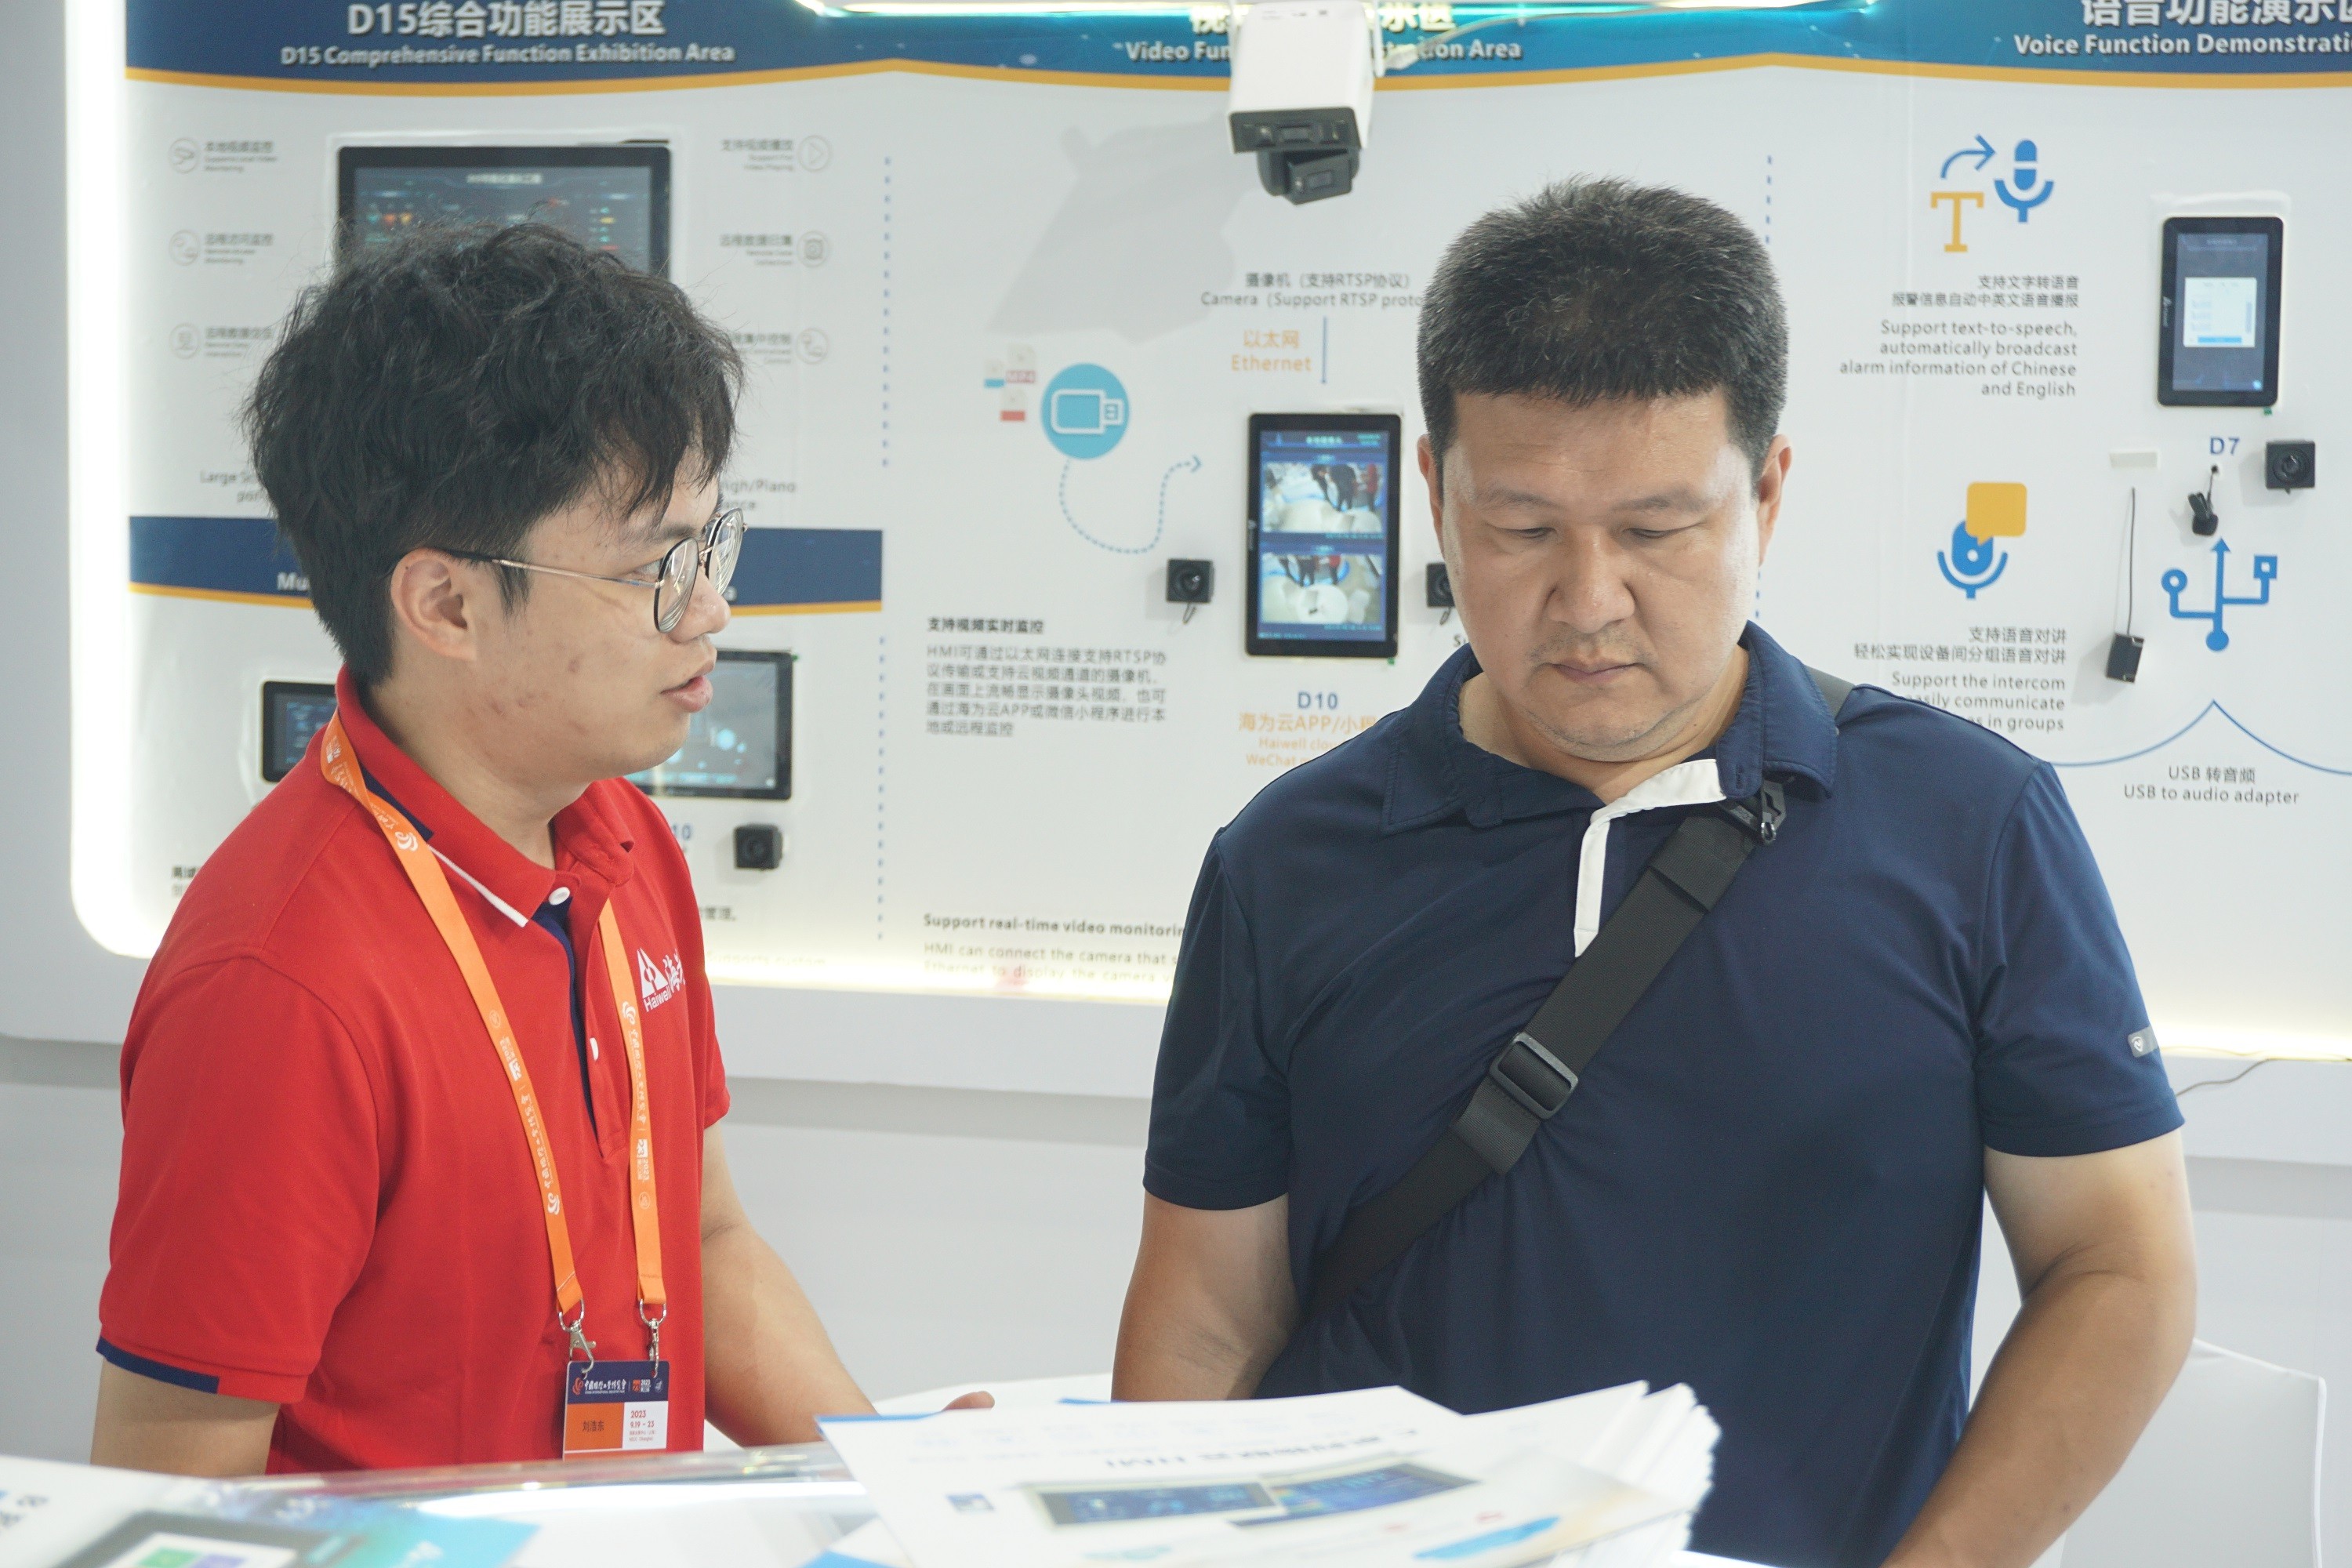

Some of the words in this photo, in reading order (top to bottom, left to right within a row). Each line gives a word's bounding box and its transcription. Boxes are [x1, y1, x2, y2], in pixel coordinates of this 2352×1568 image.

[347, 0, 666, 38] D15综合功能展示区
[1126, 41, 1191, 62] Video
[1194, 40, 1230, 62] Fun
[1468, 39, 1523, 60] Area
[2013, 34, 2080, 55] Voice
[2085, 33, 2191, 55] Function
[2197, 31, 2352, 54] Demonstrati
[281, 45, 321, 65] D15
[323, 44, 479, 69] Comprehensive
[481, 43, 572, 63] Function
[575, 42, 683, 63] Exhibition
[684, 42, 735, 63] Area
[1978, 275, 2079, 290] 支持文字转语音
[1201, 292, 1258, 307] Camera
[1340, 293, 1377, 307] RTSP
[1892, 292, 2079, 307] 报警信息自动中英文语音播报
[1881, 319, 1947, 338] Support
[1243, 329, 1299, 349] 以太网
[1880, 340, 1991, 358] automatically
[1996, 341, 2078, 357] broadcast
[1232, 354, 1312, 372] Ethernet
[1839, 359, 1885, 375] alarm
[1889, 360, 1986, 376] information
[1991, 361, 2007, 376] of
[2012, 361, 2076, 376] Chinese
[1981, 382, 2012, 397] and
[2017, 382, 2076, 400] English
[2209, 436, 2240, 455] D7
[277, 571, 310, 591] Mu
[1969, 626, 2067, 644] 支持语音对讲
[1853, 643, 2067, 664] 轻松实现设备间分组语音对讲
[1892, 671, 1957, 691] Support
[1962, 673, 1988, 688] the
[1993, 673, 2065, 691] intercom
[1298, 691, 1338, 710] D10
[1955, 695, 2064, 711] communicate
[1988, 713, 2002, 728] in
[2007, 715, 2063, 732] groups
[2169, 765, 2201, 781] USB
[2206, 766, 2256, 783] 转音频
[2124, 784, 2156, 799] USB
[2161, 786, 2177, 800] to
[2183, 786, 2229, 802] audio
[2234, 788, 2299, 806] adapter
[924, 913, 985, 931] Support
[989, 916, 1058, 933] real-time
[1063, 920, 1105, 935] video
[1109, 921, 1183, 938] monitorin
[924, 943, 953, 955] HMI
[959, 946, 984, 956] can
[989, 947, 1045, 960] connect
[1051, 949, 1074, 960] the
[1079, 952, 1131, 963] camera
[1138, 953, 1165, 964] that
[643, 985, 673, 1012] Haiwell
